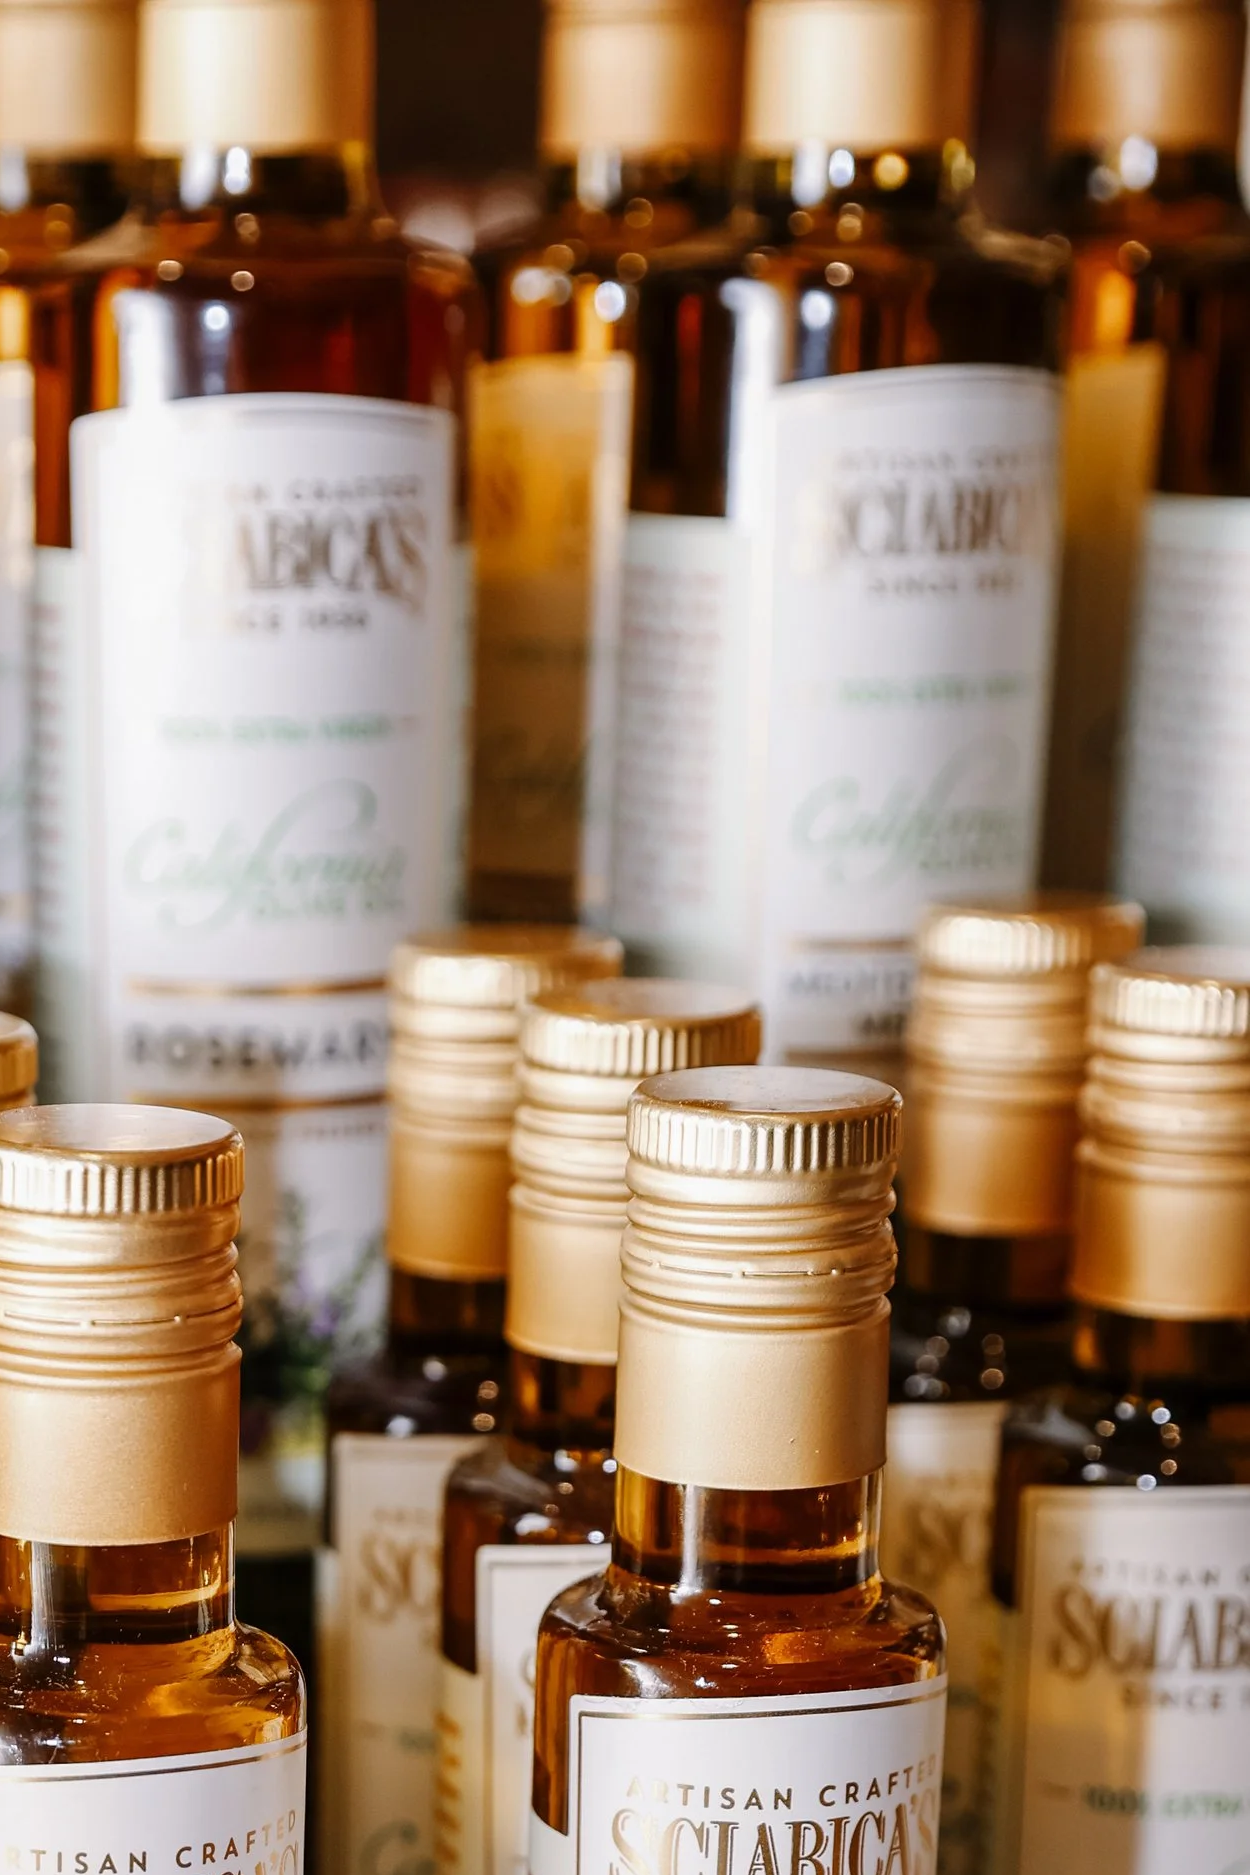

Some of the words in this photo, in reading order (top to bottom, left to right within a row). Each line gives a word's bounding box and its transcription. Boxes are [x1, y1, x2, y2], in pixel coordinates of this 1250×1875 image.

[626, 1775, 793, 1811] ARTISAN
[818, 1752, 938, 1807] CRAFTED
[175, 1808, 298, 1870] CRAFTED
